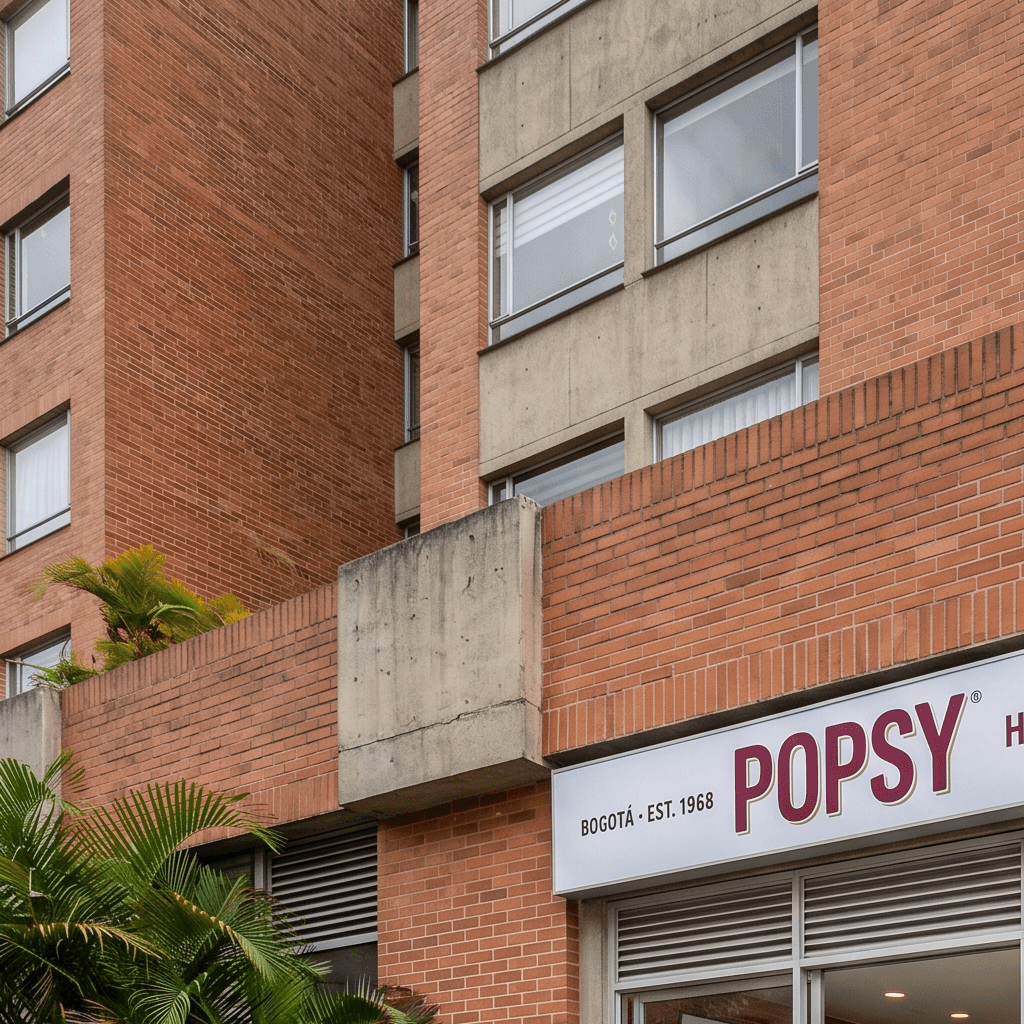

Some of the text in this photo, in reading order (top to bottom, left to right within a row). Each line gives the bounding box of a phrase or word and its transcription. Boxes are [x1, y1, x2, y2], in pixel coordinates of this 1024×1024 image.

[581, 791, 714, 837] BOGOTÁ EST. 1968
